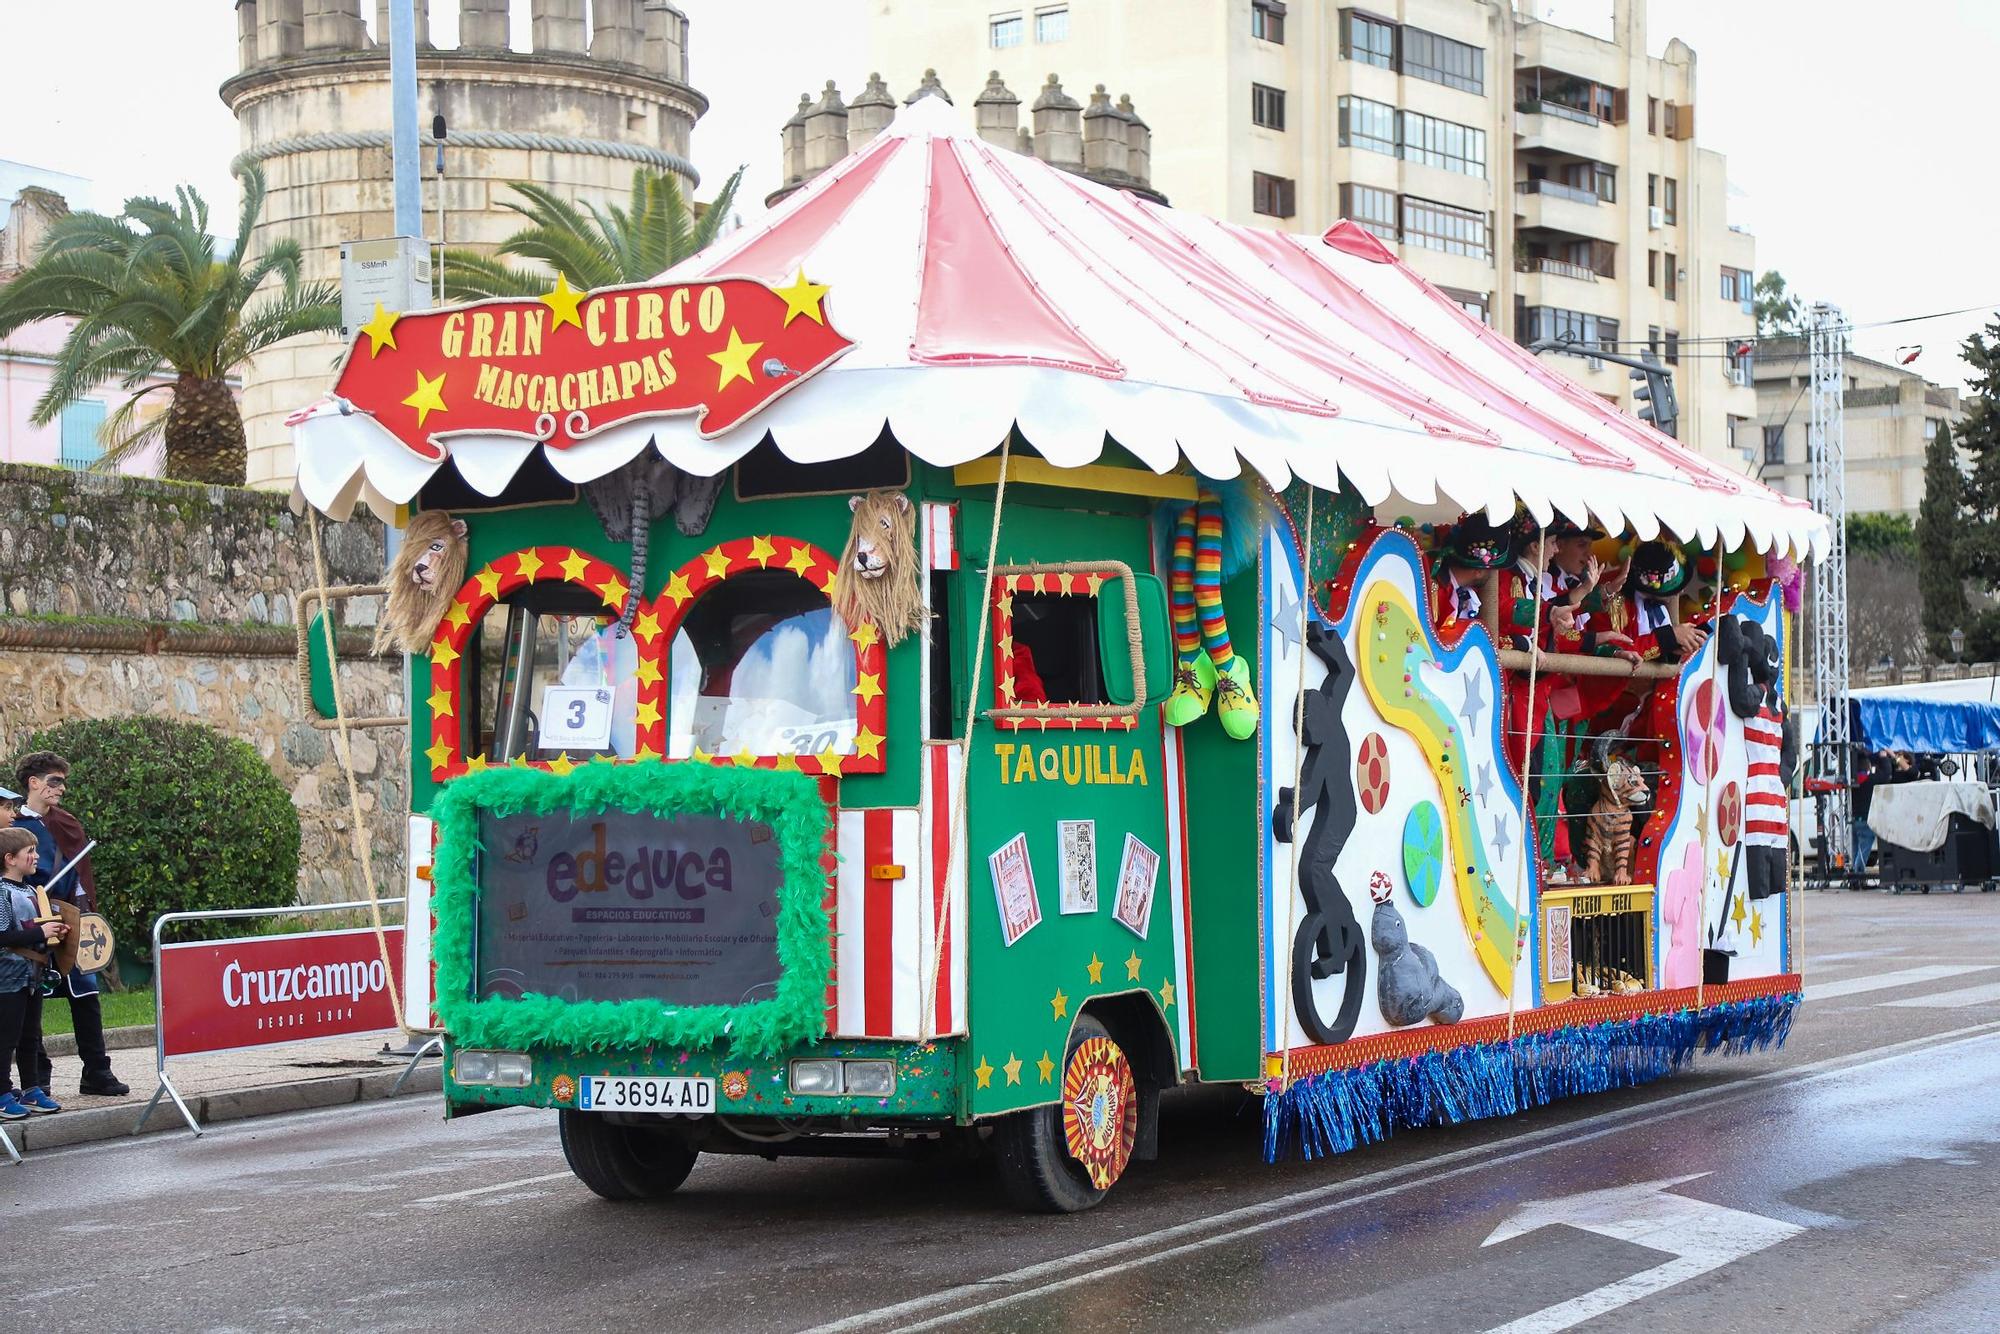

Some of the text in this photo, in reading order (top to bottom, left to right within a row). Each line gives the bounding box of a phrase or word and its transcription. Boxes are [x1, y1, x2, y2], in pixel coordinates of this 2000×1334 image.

[441, 285, 726, 358] GRAN CIRCO
[473, 347, 679, 413] MASCACHAPAS
[566, 699, 587, 729] 3
[994, 743, 1148, 785] TAQUILLA
[546, 822, 732, 903] ededuca
[586, 910, 692, 920] ESPACIOS EDUCATIVOS
[559, 947, 587, 957] Parques
[618, 933, 660, 943] Laboratorio
[665, 933, 701, 944] Mobiliario
[704, 934, 731, 944] Escolar
[222, 958, 386, 1008] Cruzcampo
[257, 1007, 353, 1030] DESDE 1904
[584, 1081, 710, 1107] E Z 3694 AD
